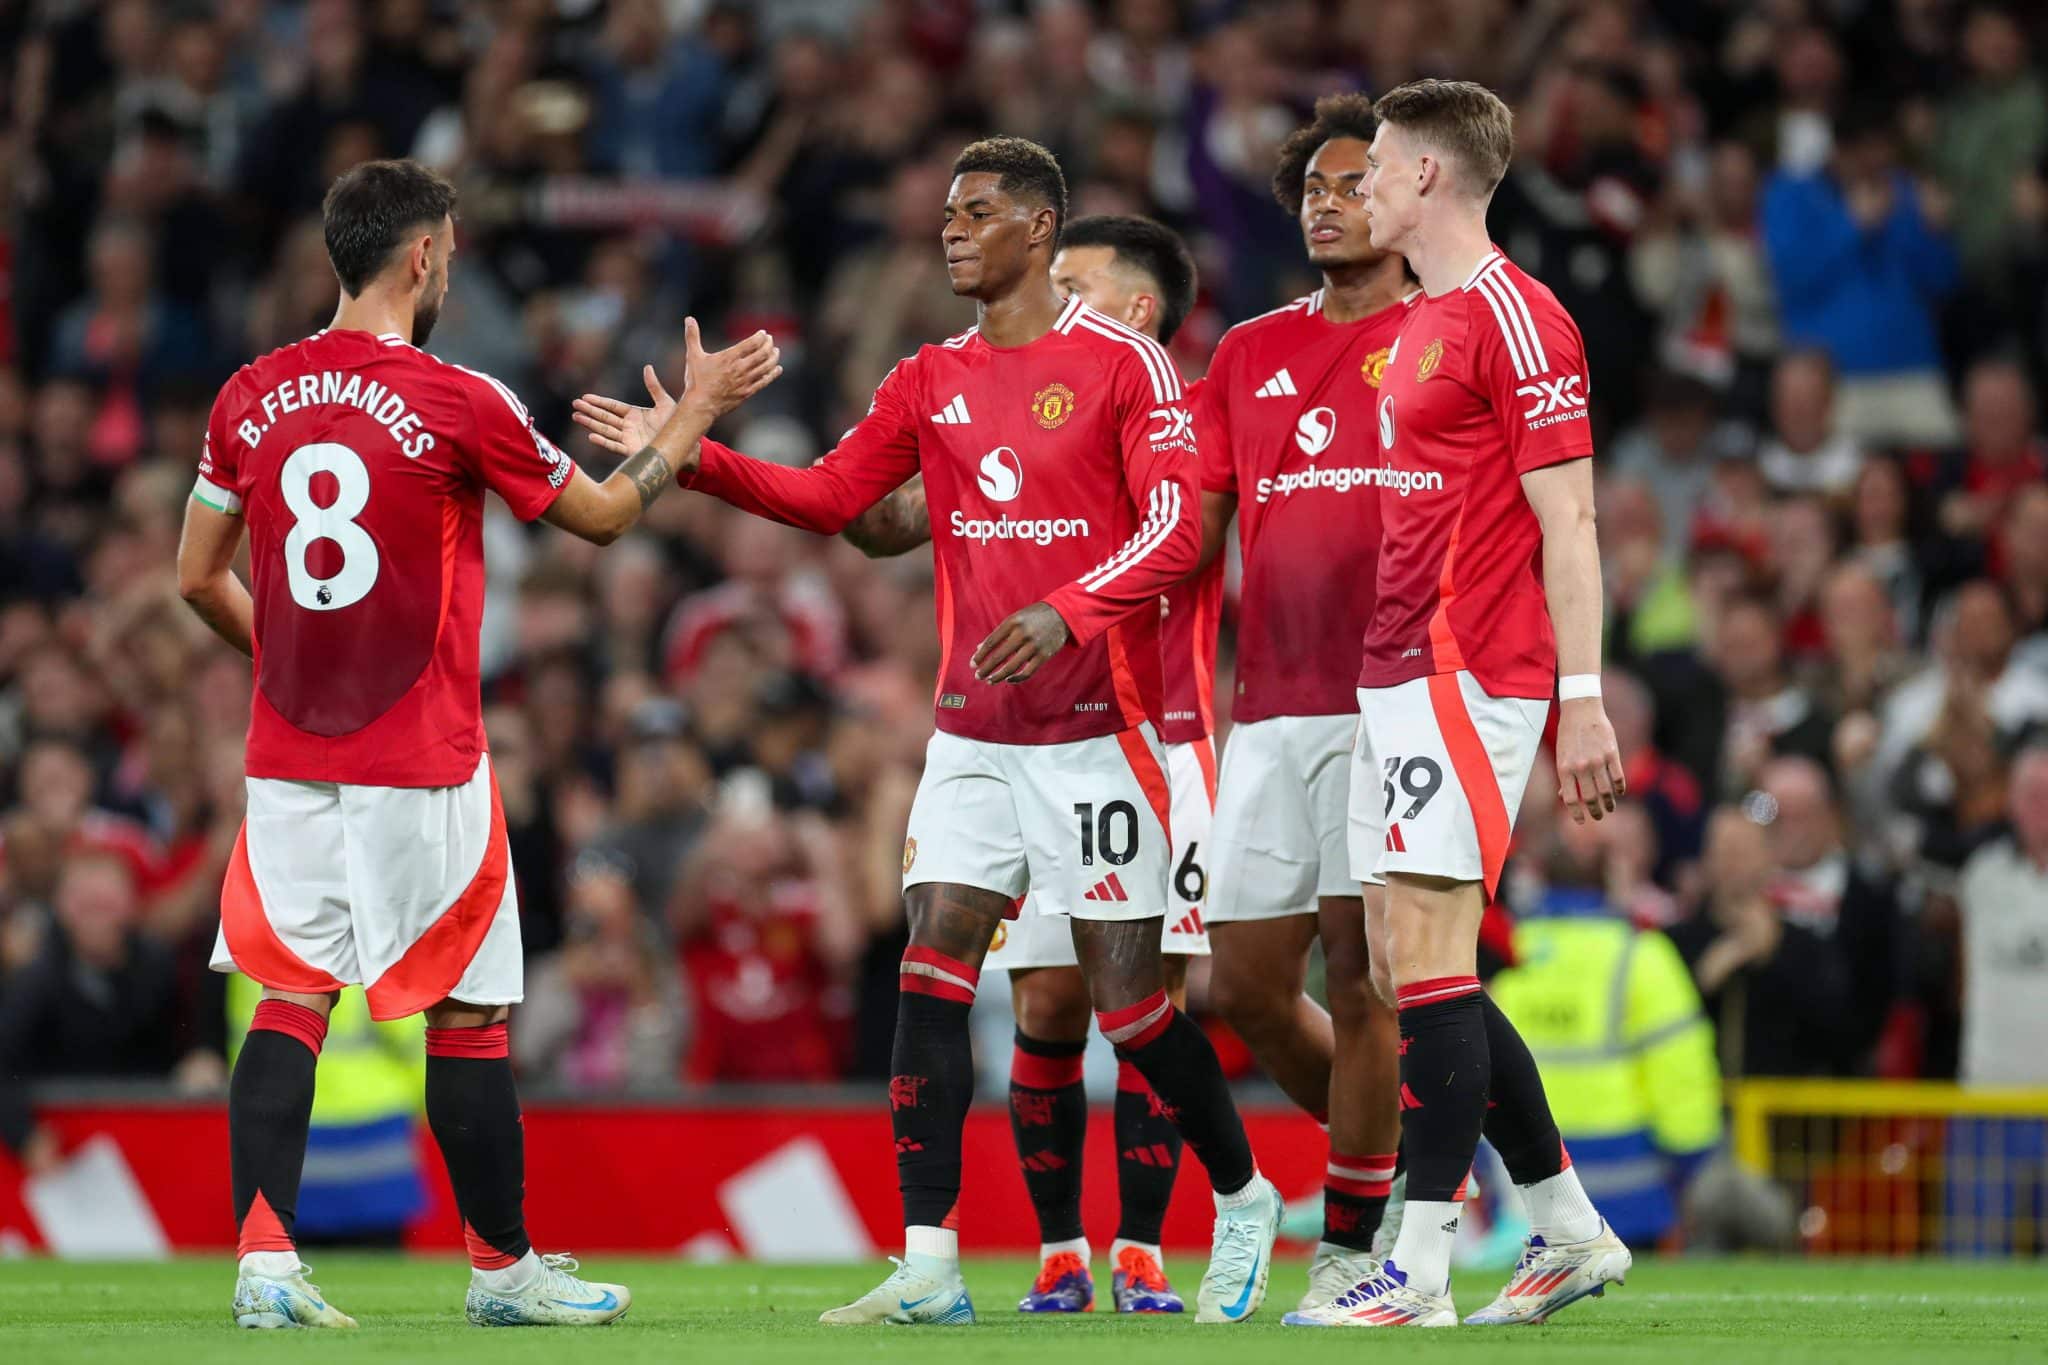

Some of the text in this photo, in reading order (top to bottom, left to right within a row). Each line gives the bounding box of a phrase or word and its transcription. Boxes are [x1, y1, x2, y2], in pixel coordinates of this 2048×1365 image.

[238, 371, 435, 459] B.FERNANDES
[1515, 375, 1586, 419] DXC
[1528, 409, 1588, 431] TECHNOLOG
[1256, 464, 1381, 503] Sapdragon
[281, 442, 379, 611] 8
[950, 510, 1089, 546] Sapdragon
[1074, 800, 1139, 866] 10
[1174, 841, 1204, 902] 6
